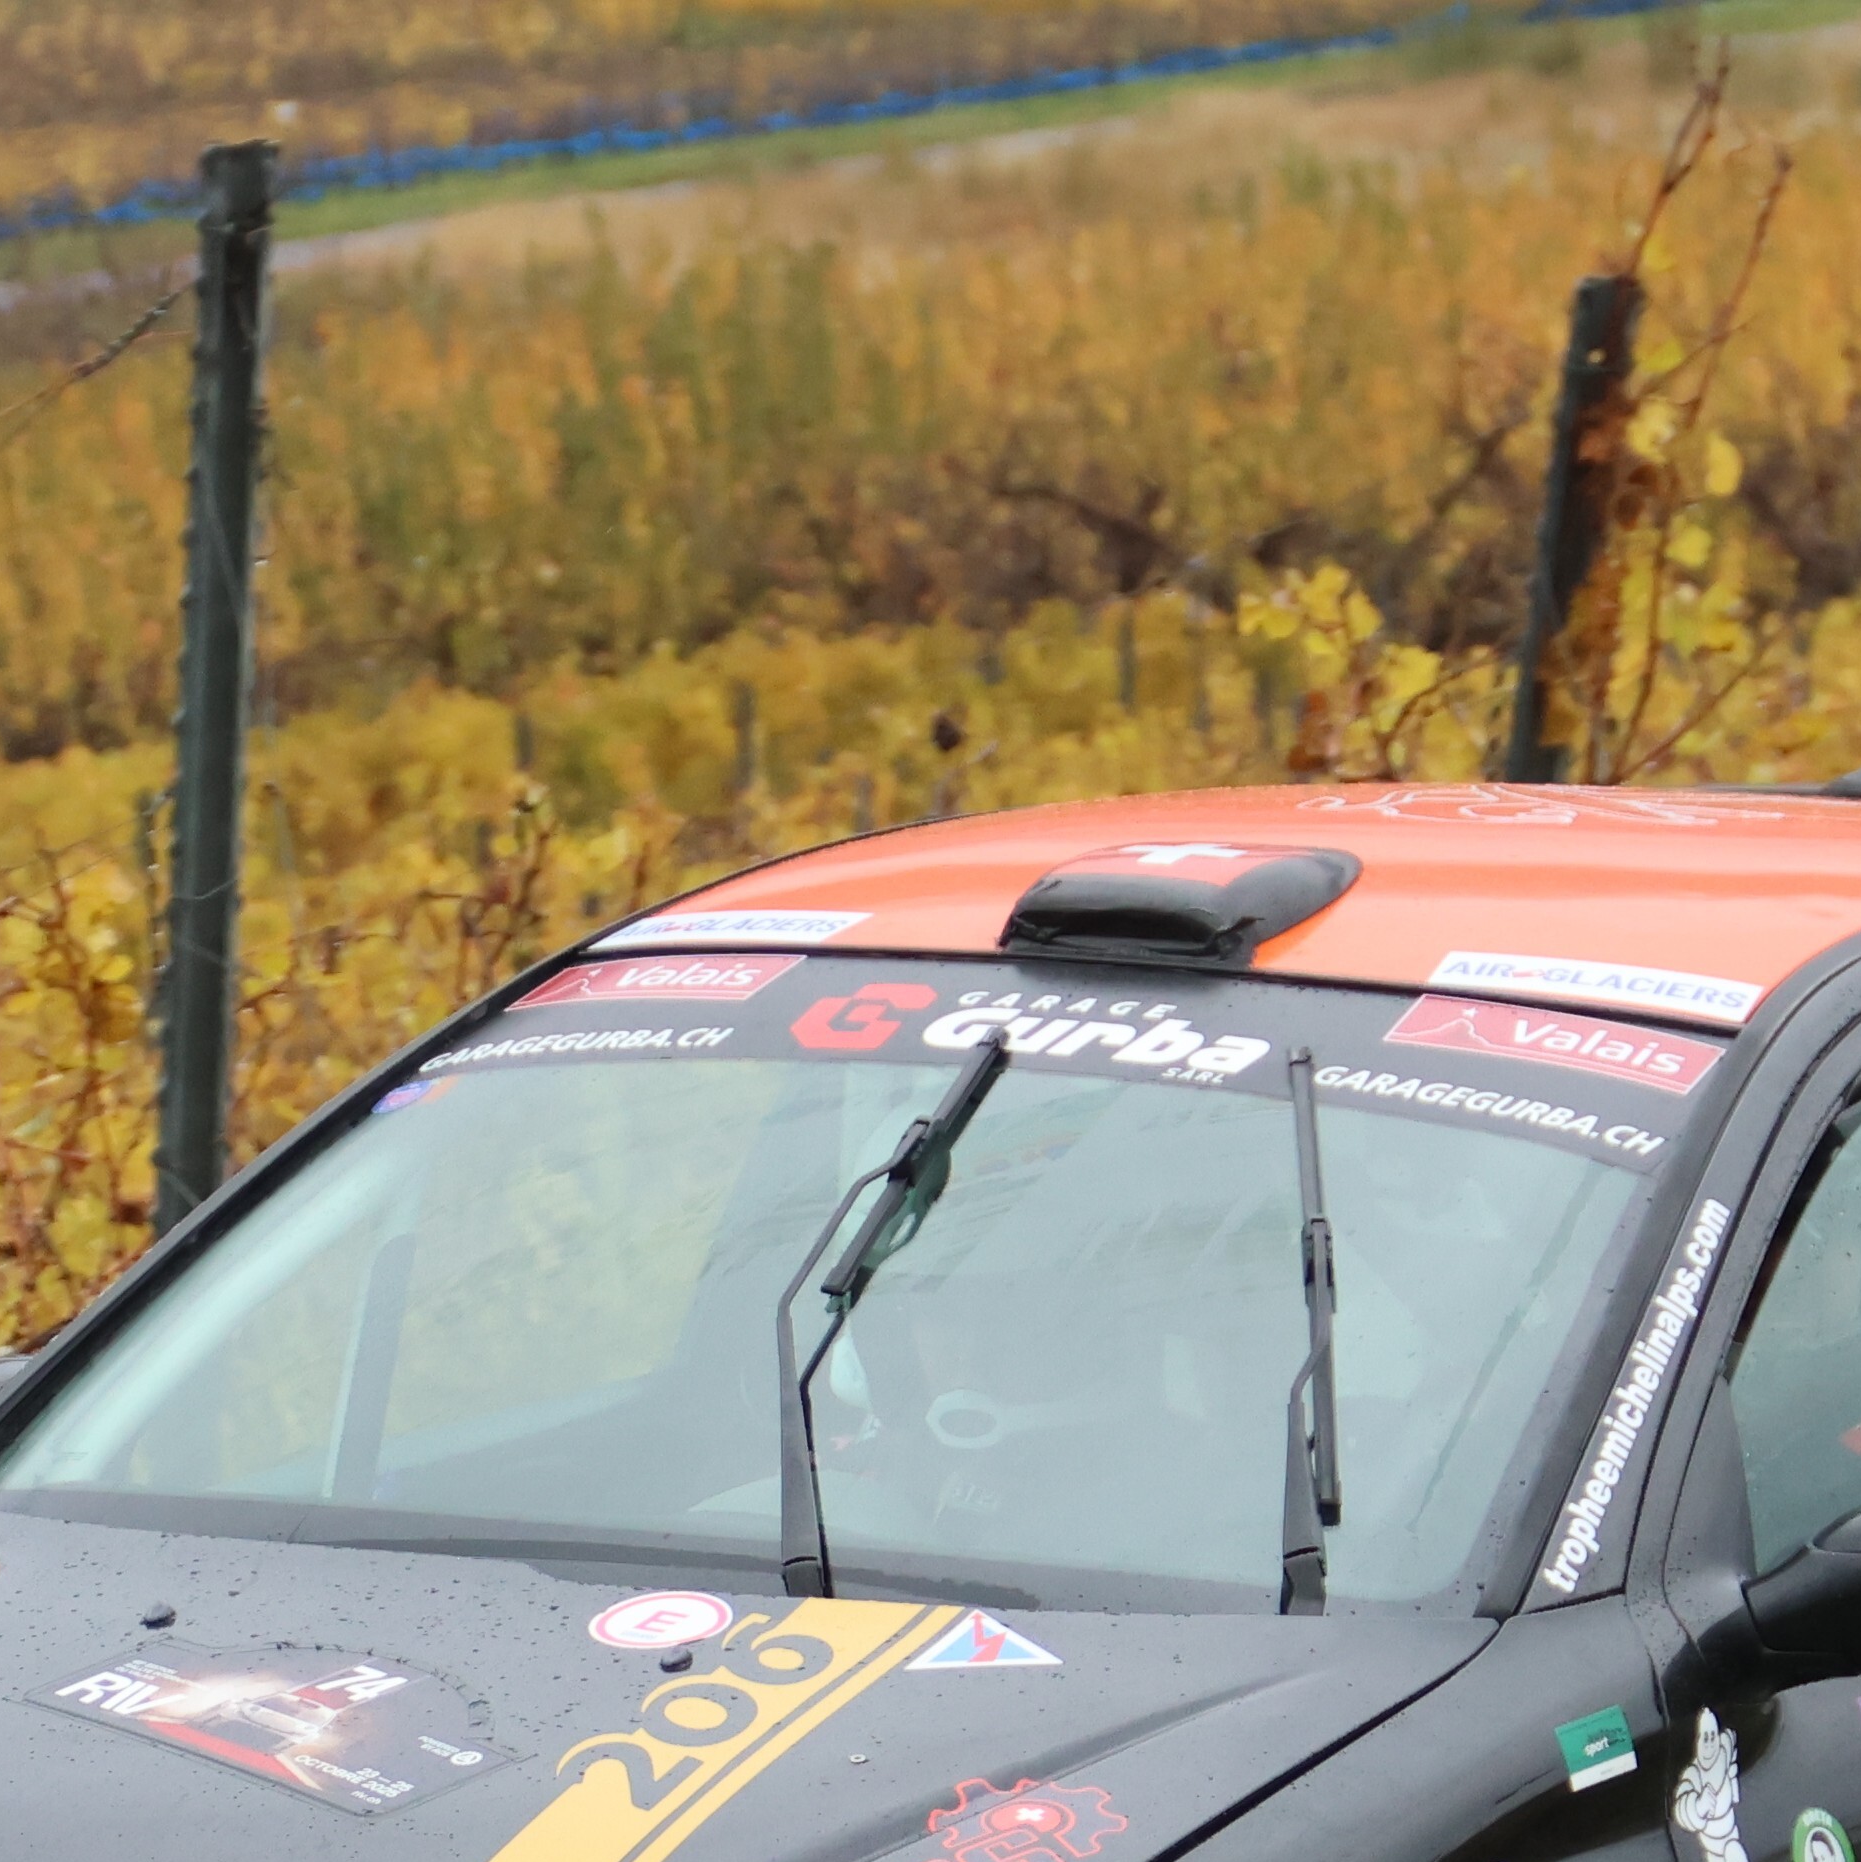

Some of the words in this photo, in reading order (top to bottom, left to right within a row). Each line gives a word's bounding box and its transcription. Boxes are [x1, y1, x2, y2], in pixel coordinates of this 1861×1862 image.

[687, 917, 848, 935] GLACIERS
[616, 962, 762, 988] Valais
[1541, 966, 1752, 1009] GLACIERS
[958, 990, 1178, 1022] GARAGE
[419, 1026, 735, 1073] GARAGEGURBA.CH
[922, 1006, 1271, 1074] Gurba
[1512, 1016, 1686, 1076] Valais
[1313, 1064, 1665, 1156] GARAGEGURBA.CH
[1543, 1197, 1731, 1593] tropheemichelinalps.com
[633, 1610, 689, 1633] E
[54, 1671, 190, 1715] RIV
[314, 1664, 409, 1701] 74
[554, 1612, 835, 1812] 206
[294, 1755, 366, 1784] OCTOBRE
